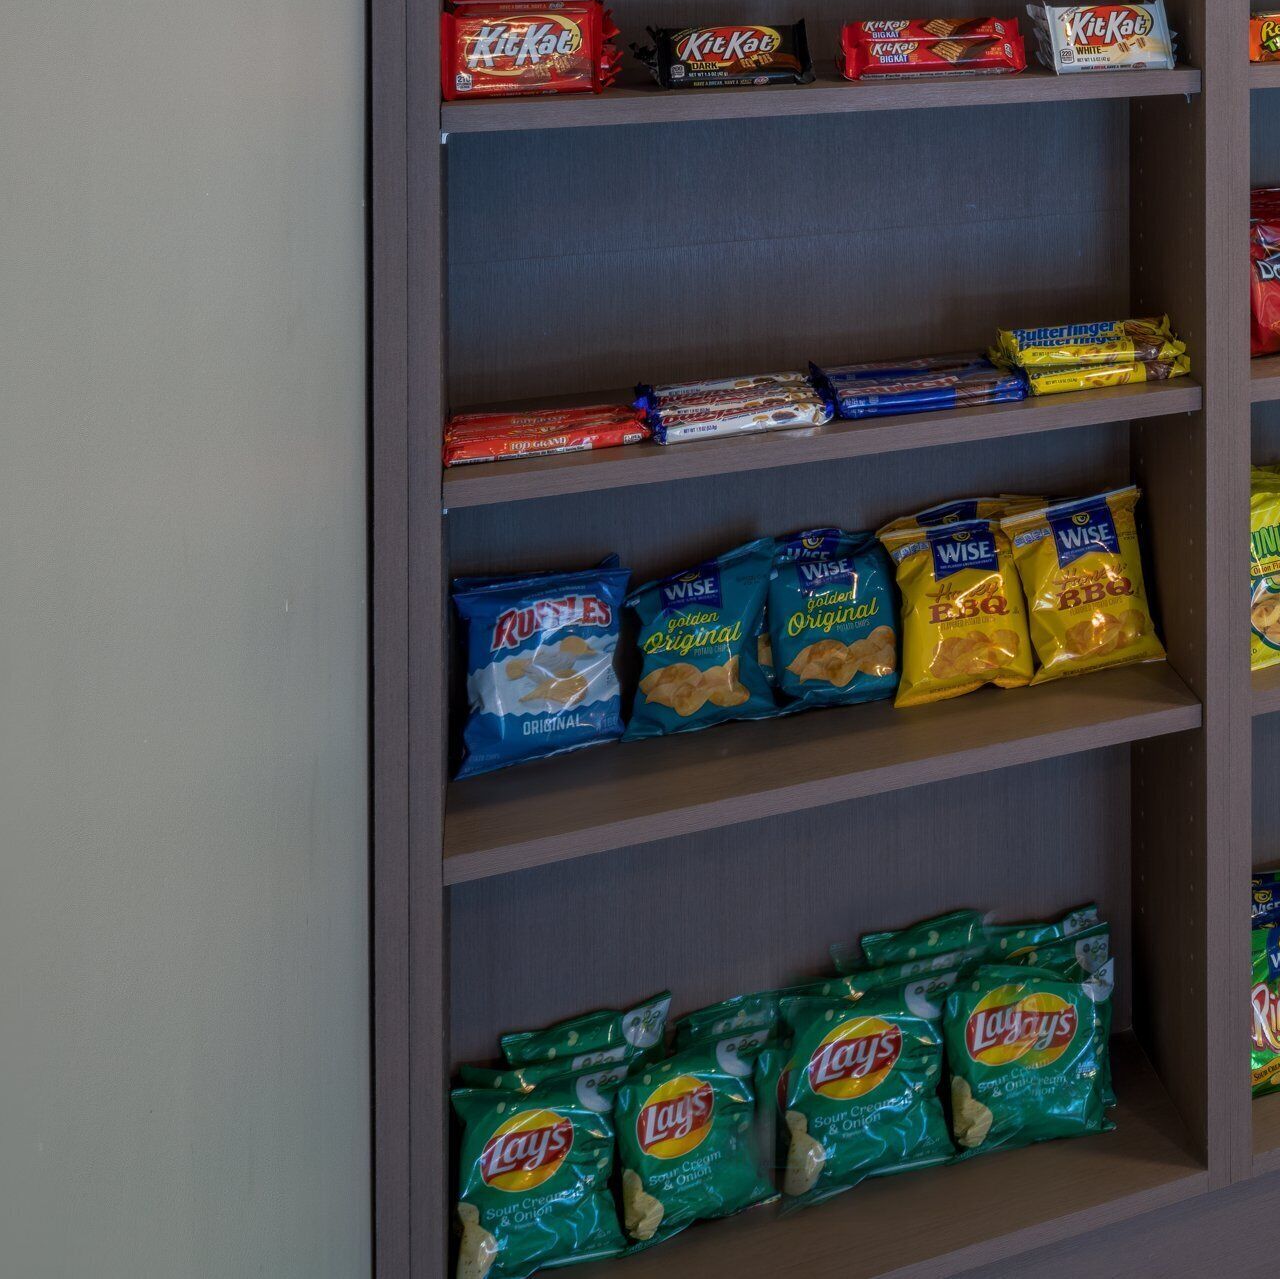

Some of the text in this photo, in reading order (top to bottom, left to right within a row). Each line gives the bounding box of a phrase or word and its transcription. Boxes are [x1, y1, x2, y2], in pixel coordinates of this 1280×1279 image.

[1076, 46, 1101, 55] WHITE
[692, 62, 718, 70] DARK
[1012, 320, 1119, 343] Butterfinger
[532, 436, 568, 447] GRAND
[1058, 523, 1115, 549] WISE
[936, 541, 994, 564] WISE
[801, 560, 852, 581] WISE
[664, 578, 719, 601] WISE
[1057, 577, 1135, 611] BBQ
[807, 592, 855, 612] golden
[928, 596, 1011, 625] BBQ
[491, 594, 612, 652] RUFFLES
[668, 611, 719, 631] golden
[787, 598, 880, 637] Original
[643, 621, 742, 656] Original
[523, 714, 582, 735] ORIGINAL
[815, 1032, 899, 1087] Lay's
[1253, 1067, 1270, 1082] SOUR
[644, 1089, 712, 1148] Lay's
[814, 1111, 848, 1129] Sour
[841, 1112, 881, 1132] Onion
[487, 1121, 574, 1179] Lay's
[649, 1149, 722, 1187] Sour Cream
[662, 1166, 713, 1192] & Onion
[486, 1206, 520, 1222] Sour
[513, 1203, 553, 1223] Onion
